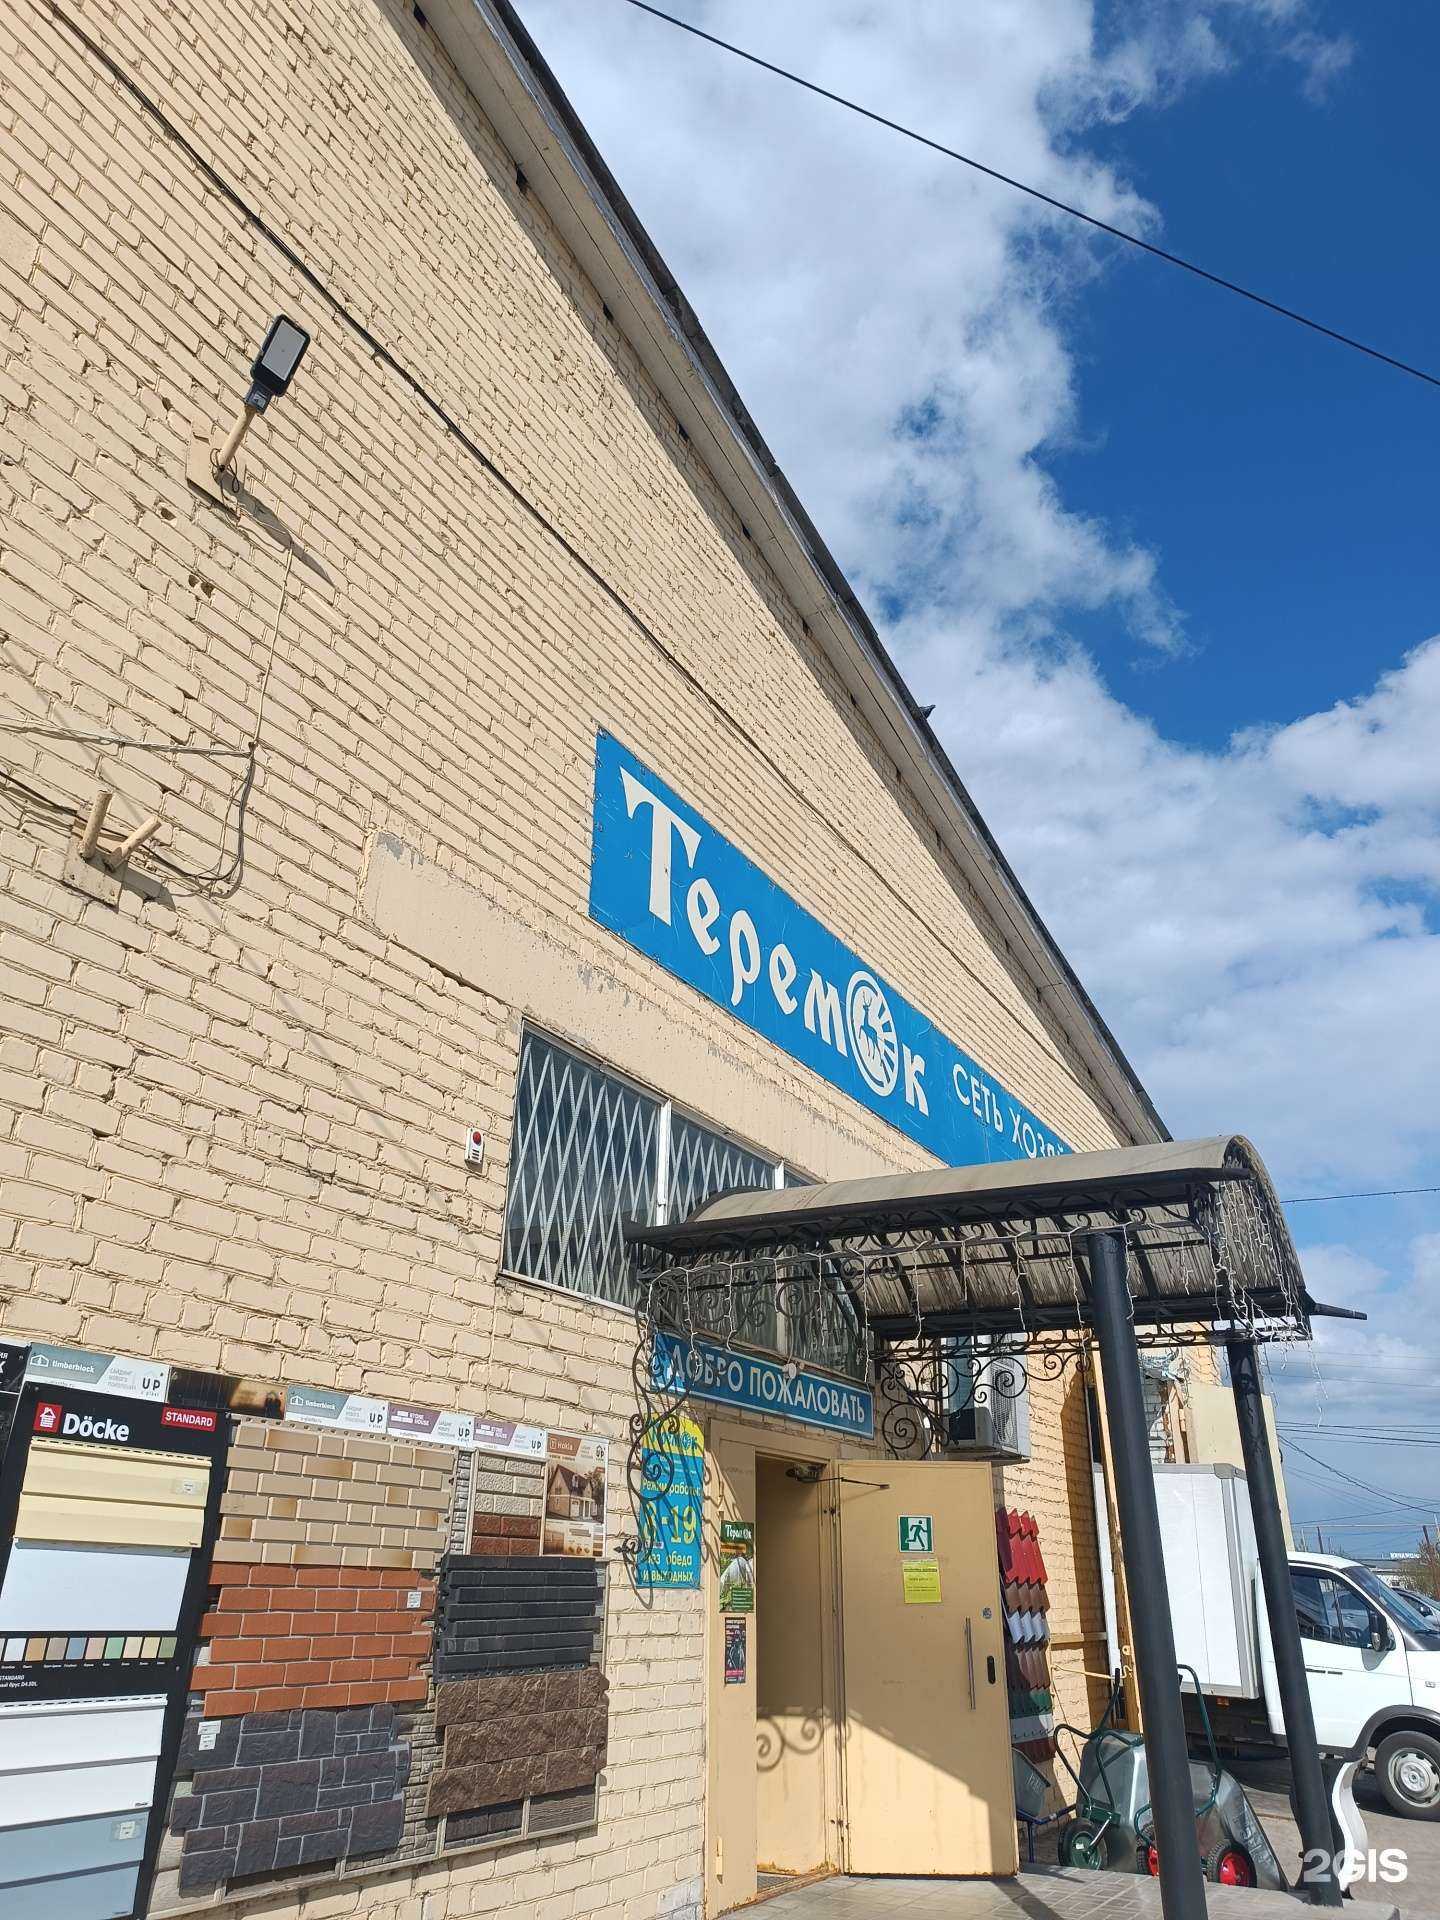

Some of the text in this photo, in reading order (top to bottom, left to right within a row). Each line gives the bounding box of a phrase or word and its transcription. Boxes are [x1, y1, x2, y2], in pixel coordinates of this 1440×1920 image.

[953, 1064, 1004, 1133] СЕТЬ
[52, 1360, 95, 1373] timberblock
[671, 1344, 865, 1423] ДОБРО ПОЖАЛОВАТЬ
[62, 1413, 130, 1442] Döcke
[165, 1411, 213, 1427] STANDARD
